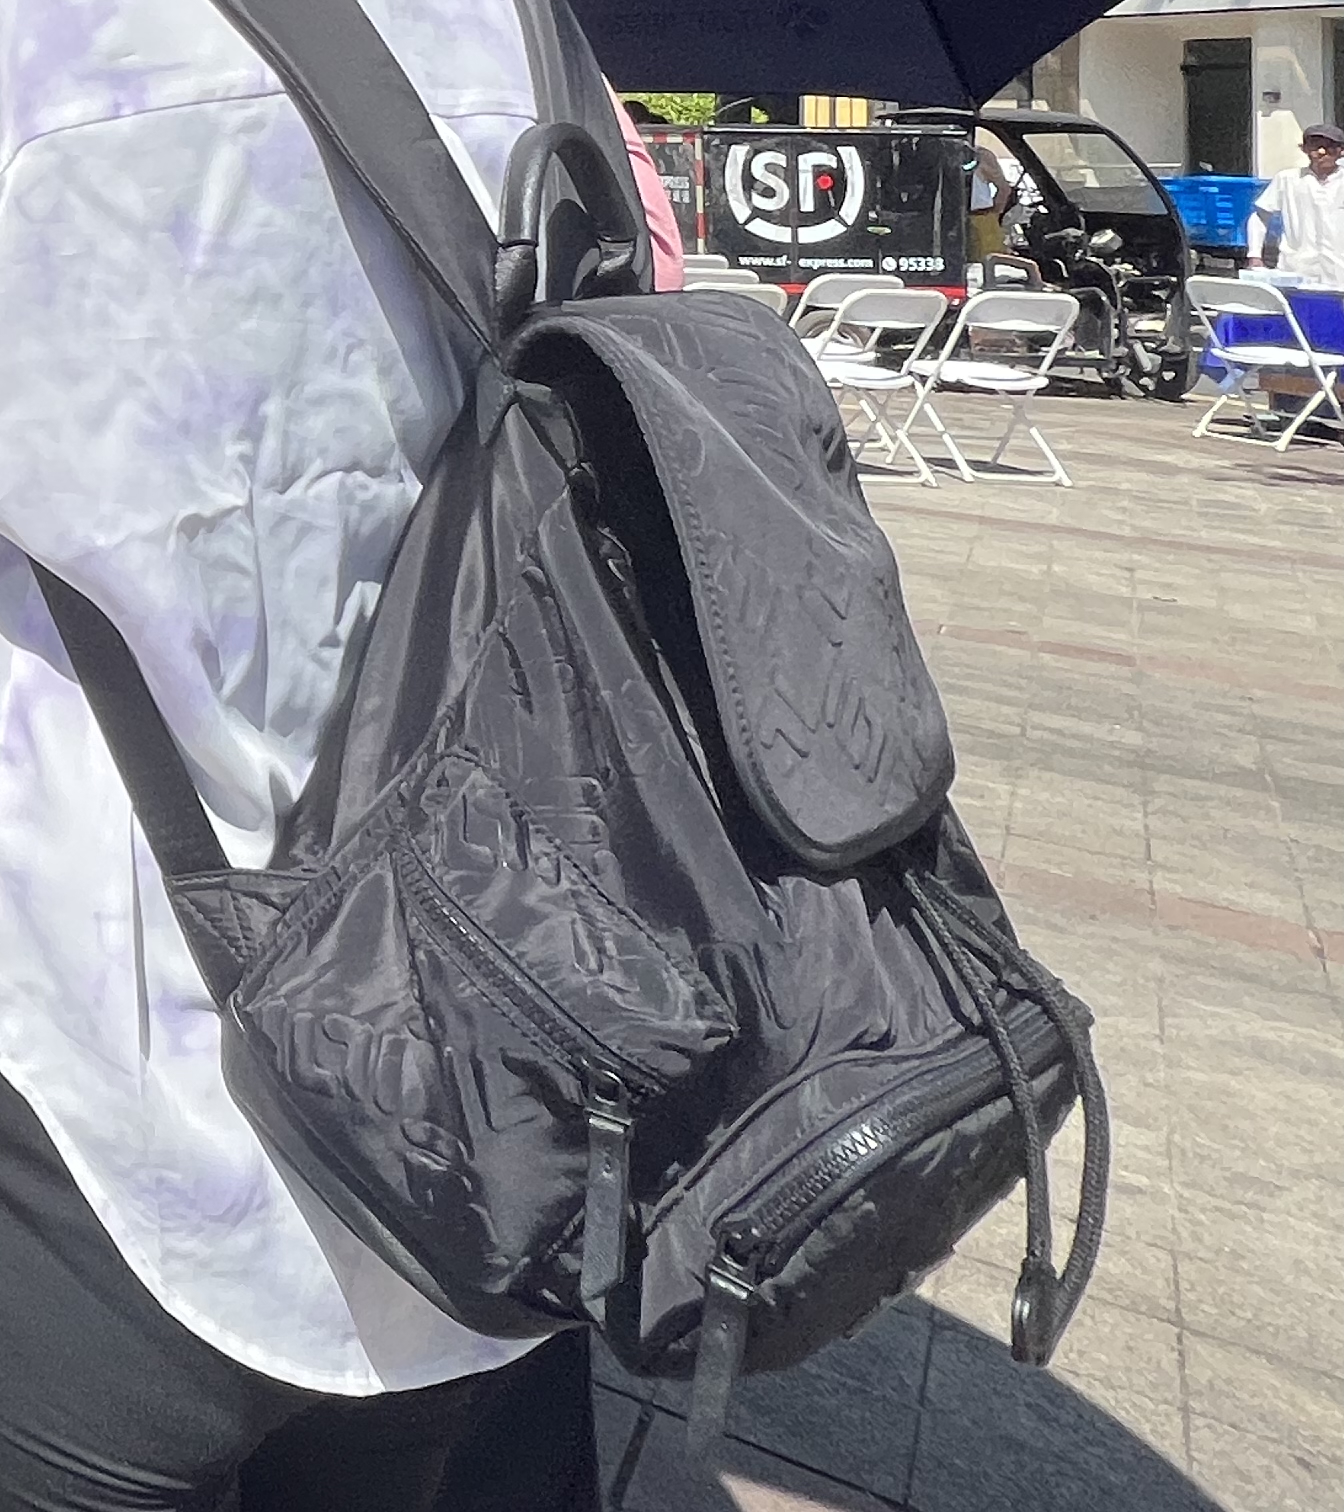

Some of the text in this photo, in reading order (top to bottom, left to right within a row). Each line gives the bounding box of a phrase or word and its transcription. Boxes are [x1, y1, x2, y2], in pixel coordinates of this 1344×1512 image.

[750, 150, 838, 213] SF
[798, 256, 874, 271] express.com
[898, 256, 945, 272] 95338
